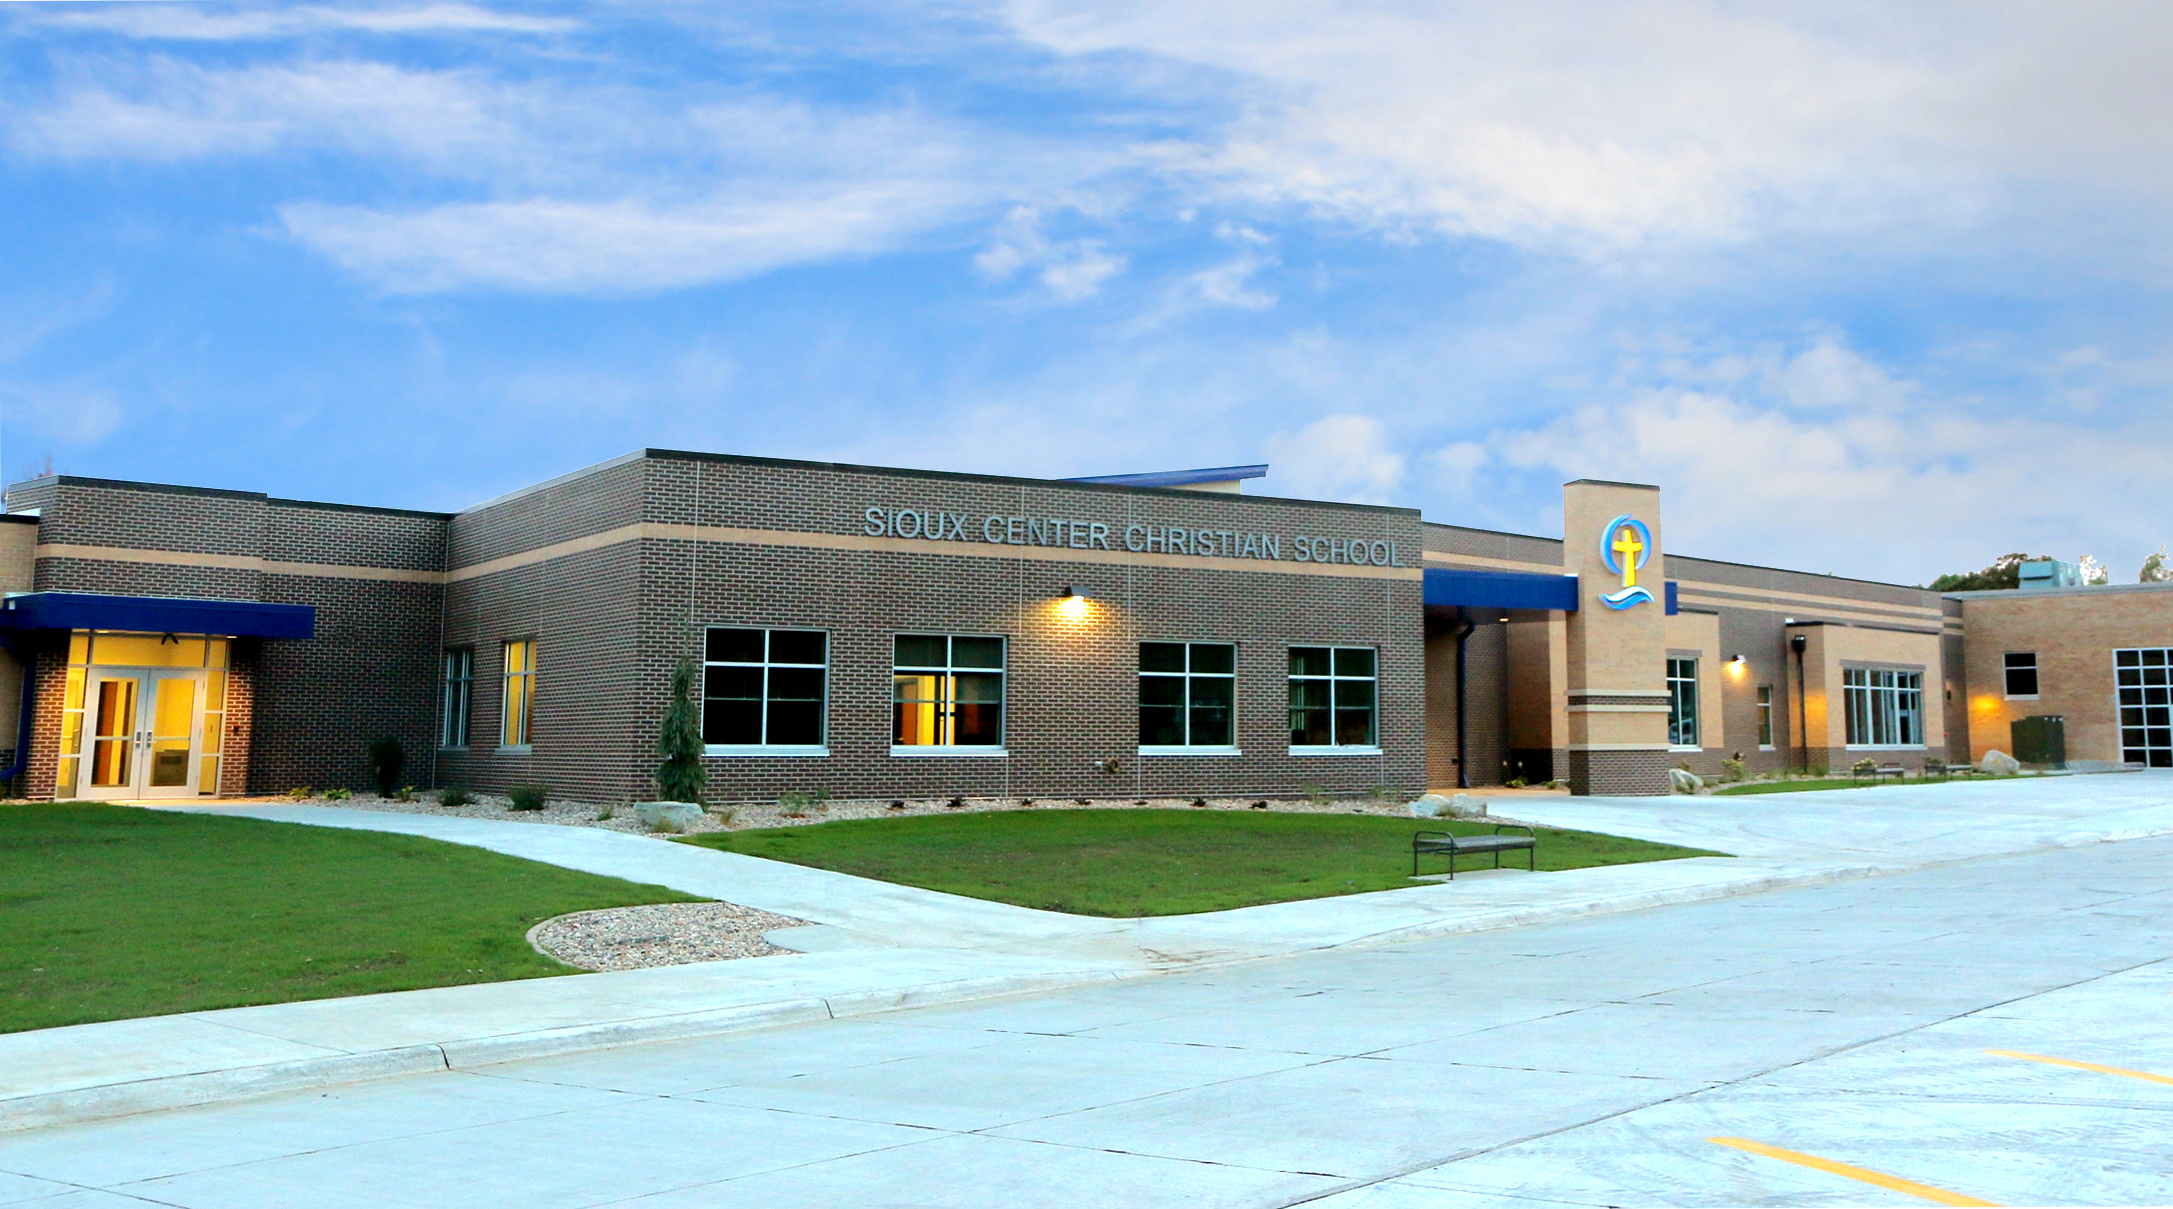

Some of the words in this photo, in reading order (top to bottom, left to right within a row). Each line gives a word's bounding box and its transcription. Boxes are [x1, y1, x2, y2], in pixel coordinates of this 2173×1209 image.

[863, 507, 968, 542] SIOUX
[983, 516, 1110, 551] CENTER
[1125, 525, 1280, 560] CHRISTIAN
[1294, 536, 1402, 568] SCHOOL
